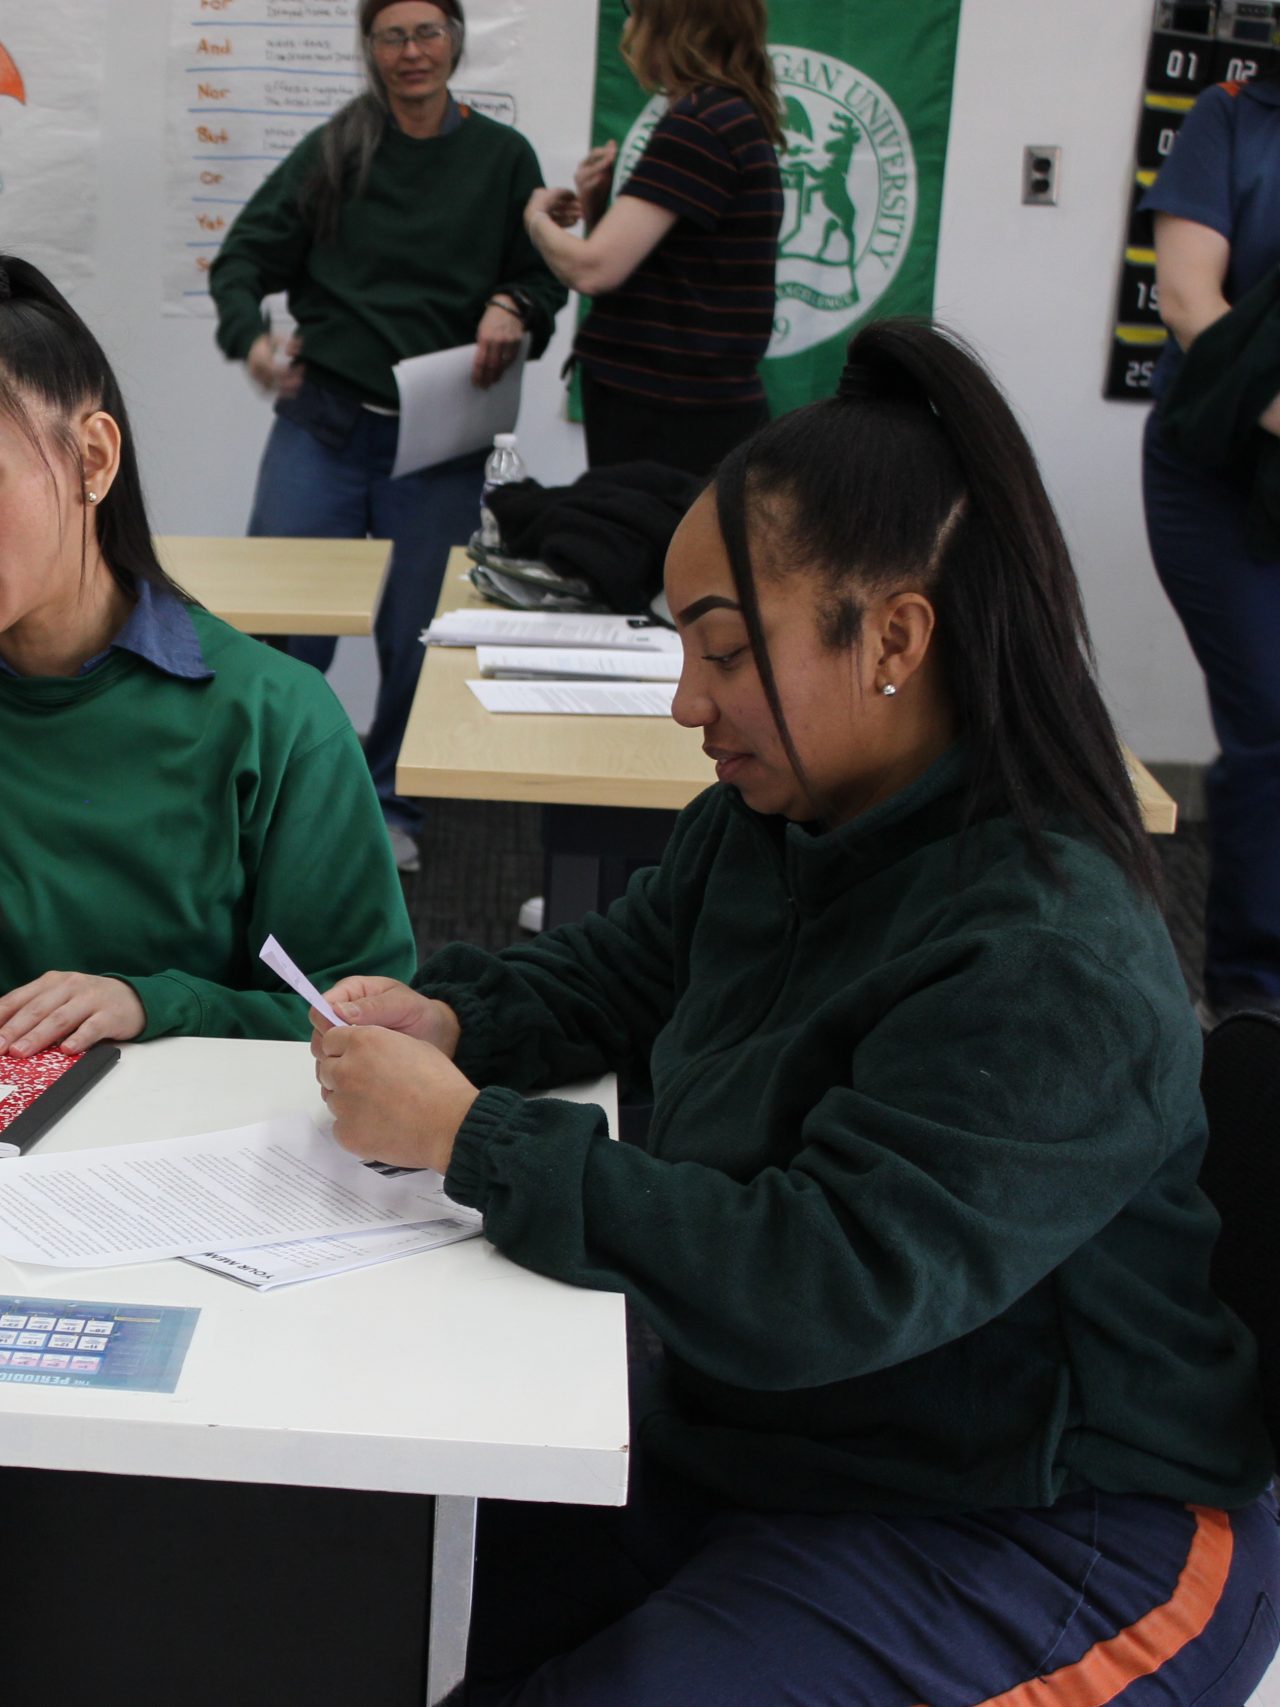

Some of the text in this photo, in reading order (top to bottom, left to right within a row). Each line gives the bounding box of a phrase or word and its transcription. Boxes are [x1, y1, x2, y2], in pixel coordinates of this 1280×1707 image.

[196, 38, 232, 56] And
[1166, 49, 1199, 80] 01
[196, 83, 231, 100] Nor
[196, 126, 229, 144] But
[1157, 129, 1179, 156] 0
[770, 52, 907, 270] GAN UNIVERSITY
[199, 170, 224, 185] Or
[1125, 360, 1155, 387] 25
[237, 1264, 275, 1279] YOUR
